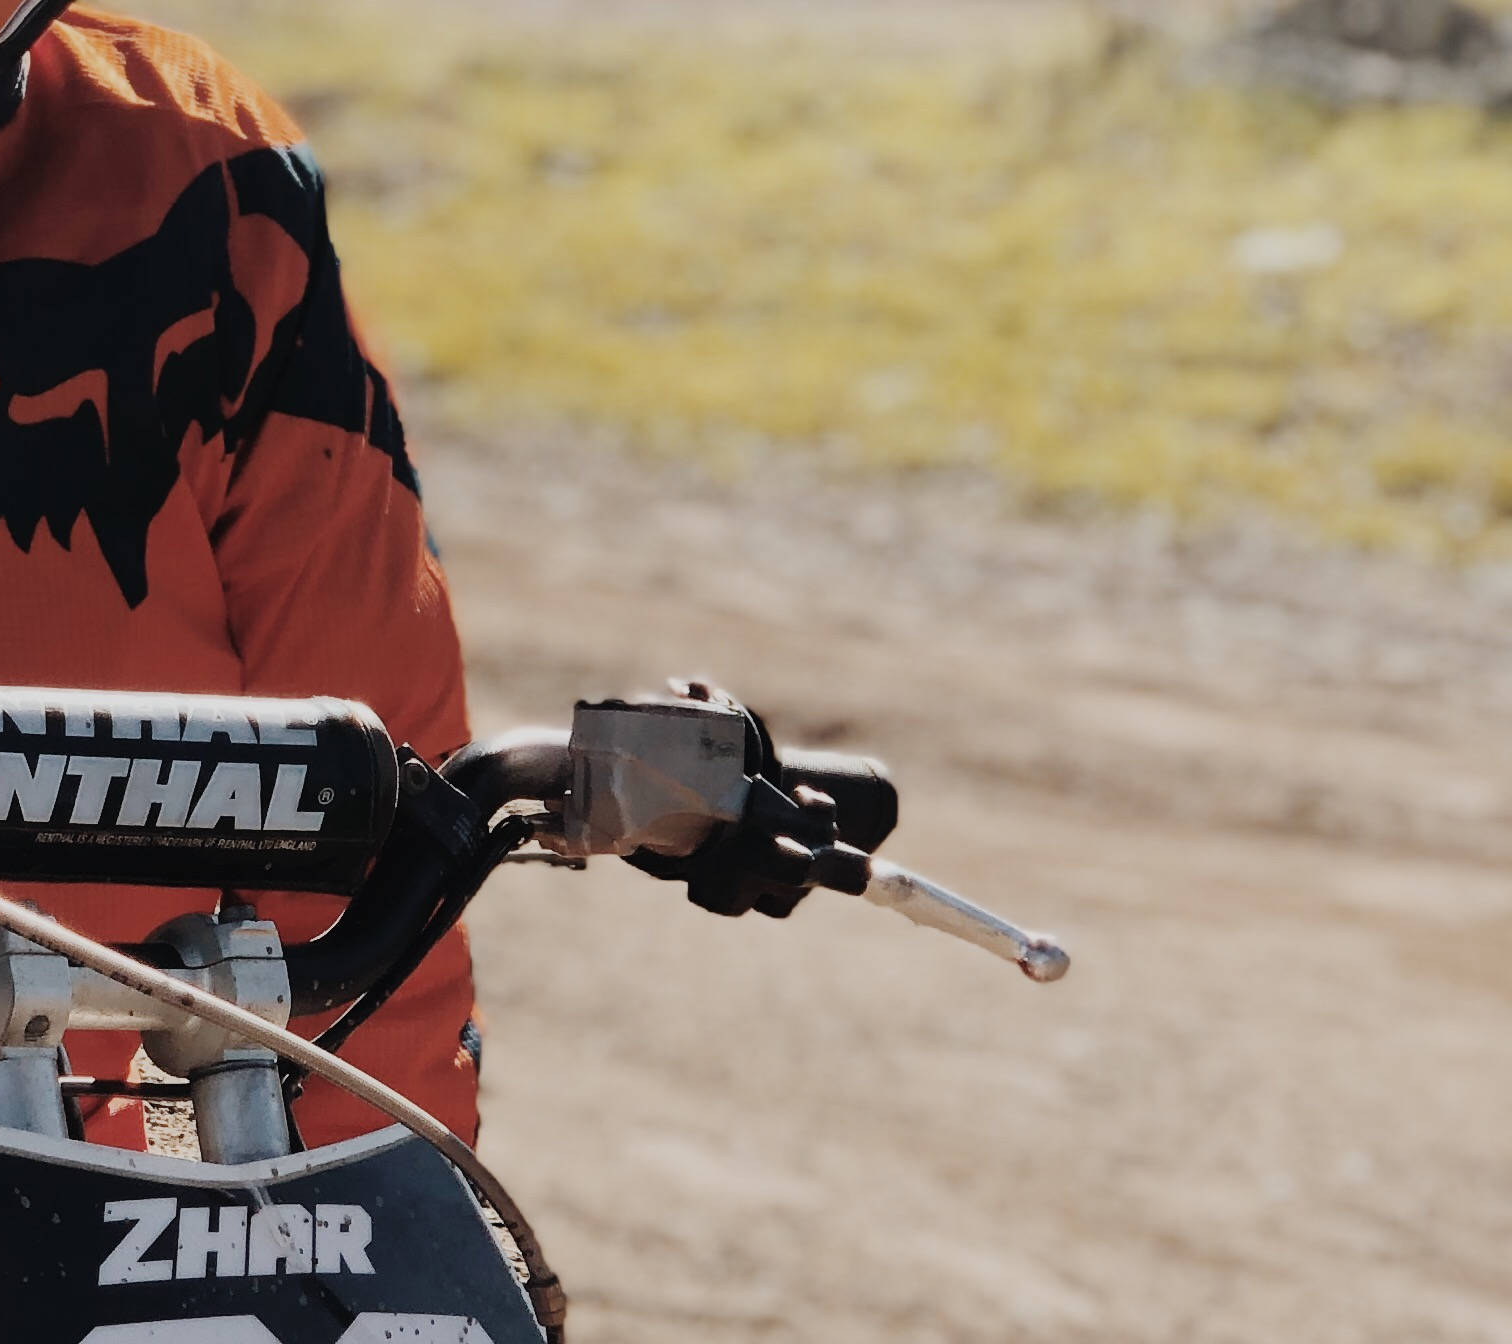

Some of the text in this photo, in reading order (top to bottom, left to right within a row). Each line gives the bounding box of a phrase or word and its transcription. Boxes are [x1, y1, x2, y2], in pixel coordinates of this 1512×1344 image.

[217, 838, 257, 850] RENTHAL
[274, 840, 317, 851] ENGLAND
[98, 1197, 376, 1286] ZHAR
